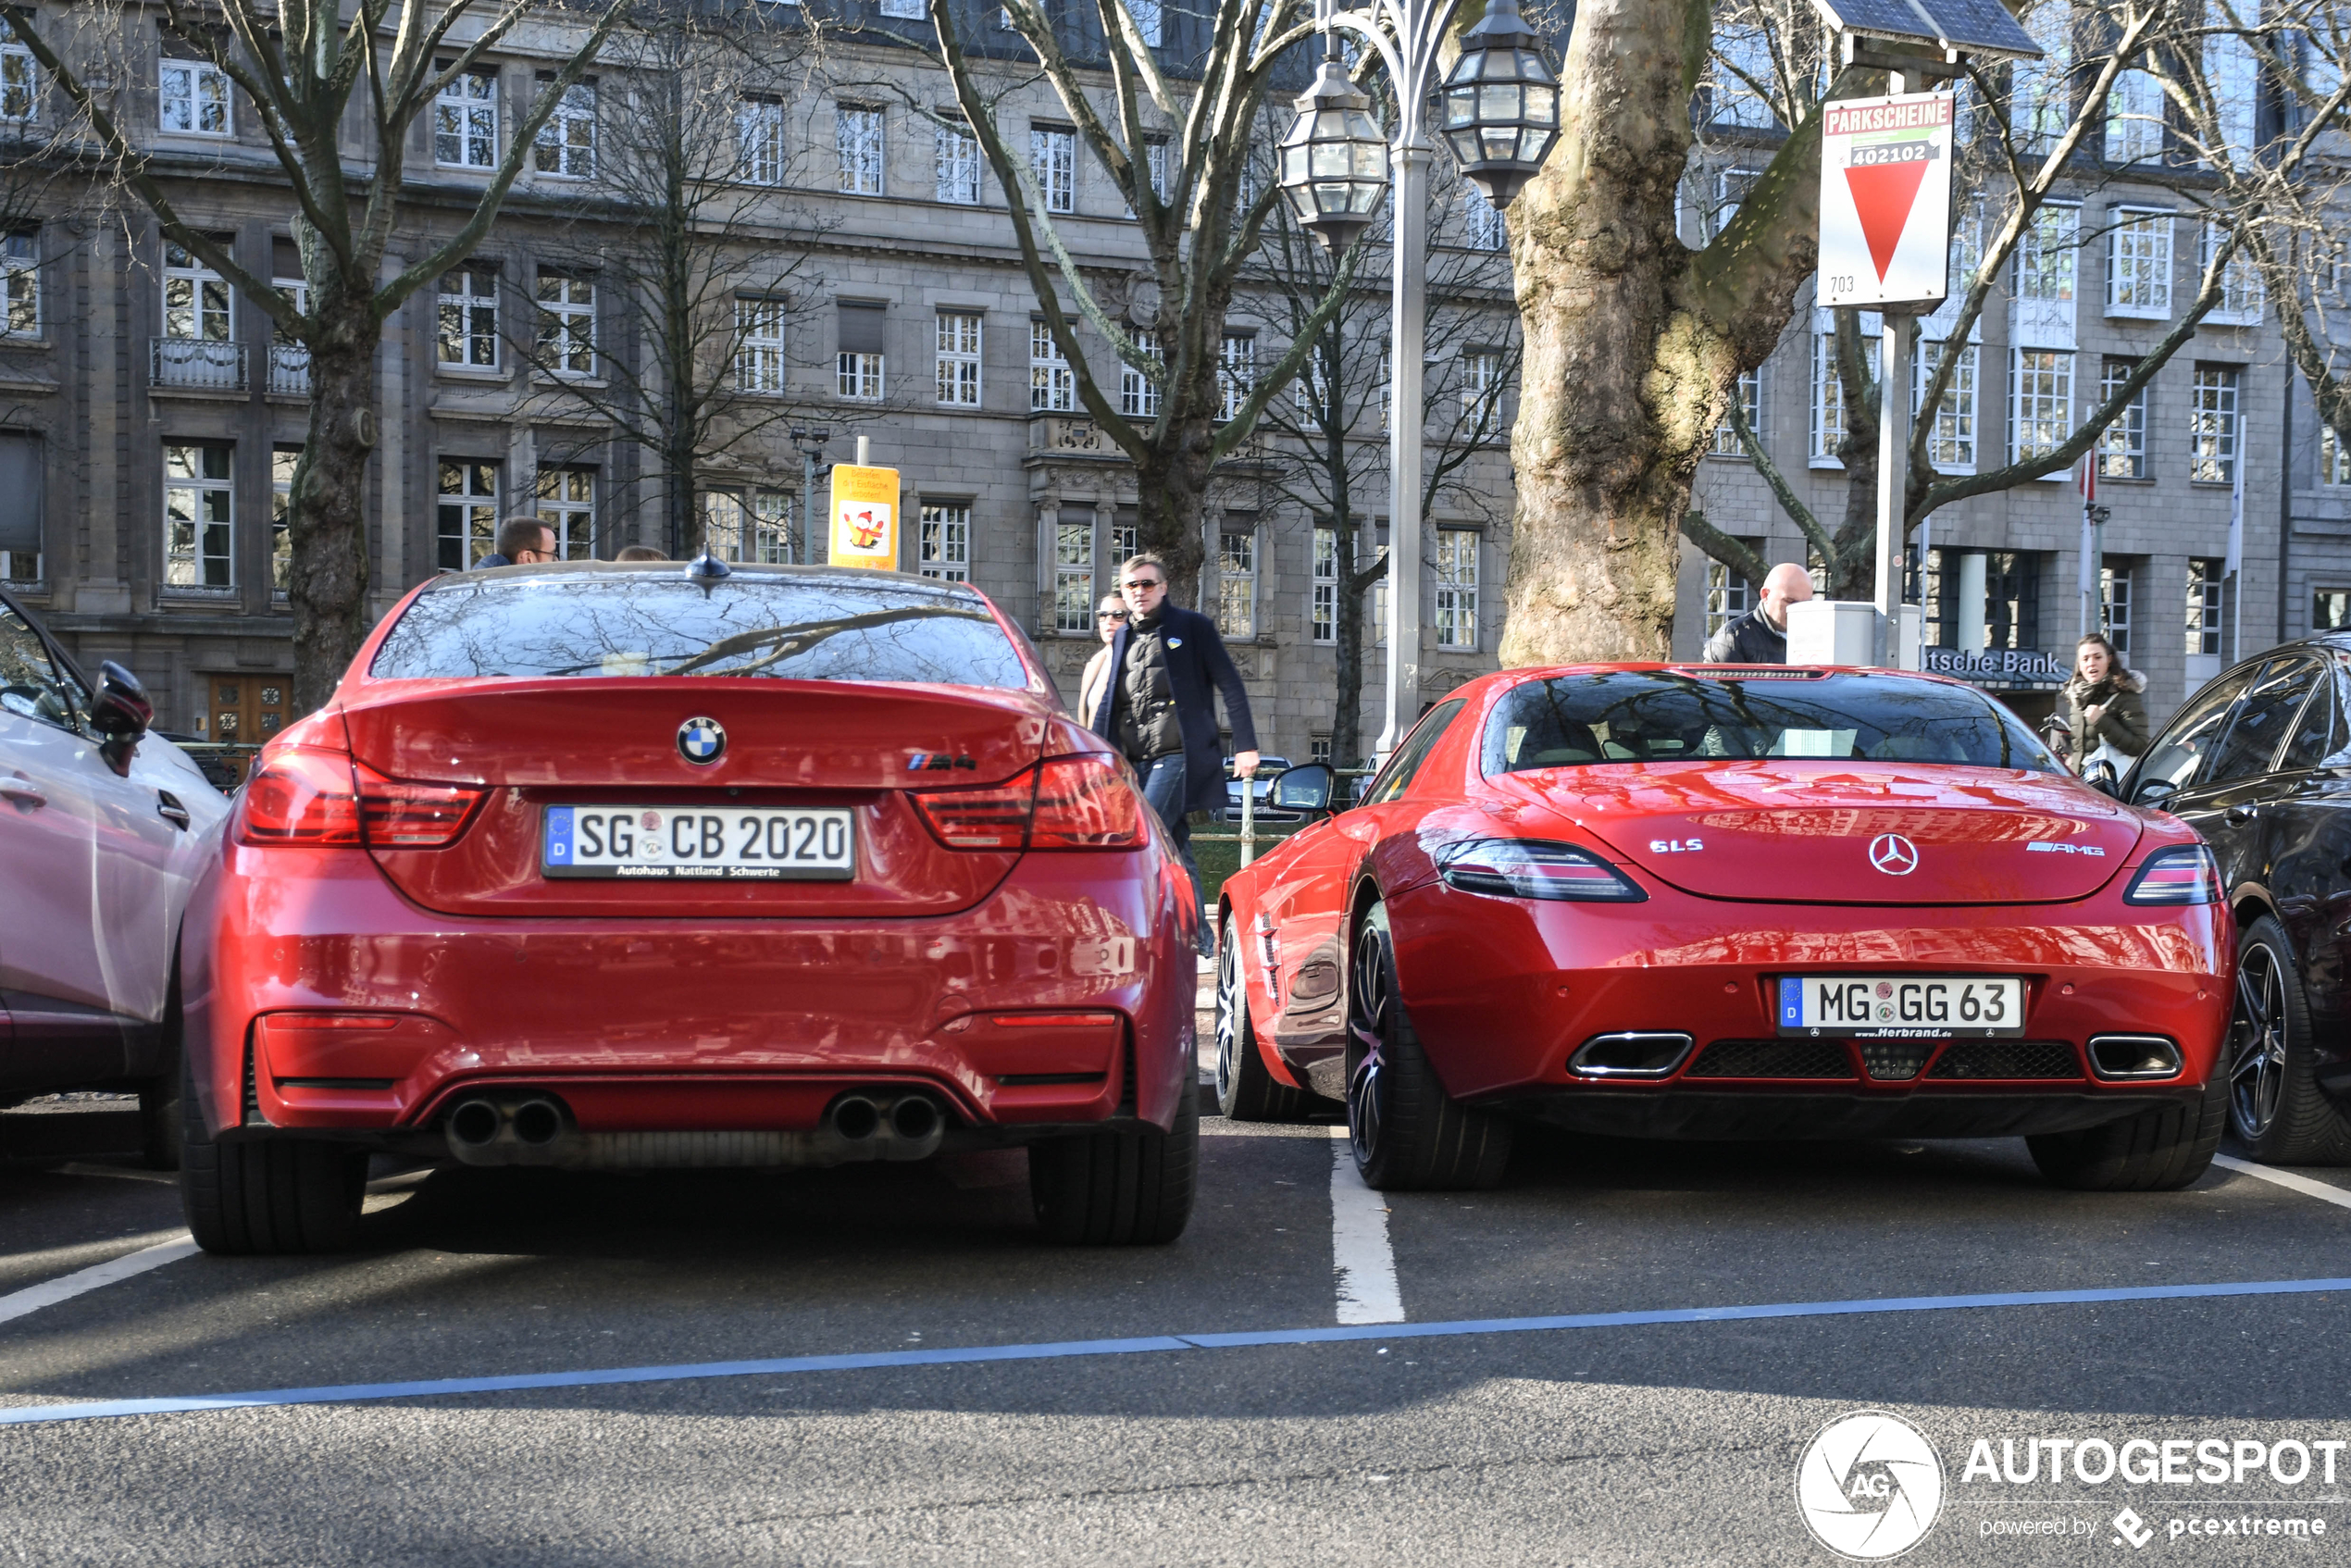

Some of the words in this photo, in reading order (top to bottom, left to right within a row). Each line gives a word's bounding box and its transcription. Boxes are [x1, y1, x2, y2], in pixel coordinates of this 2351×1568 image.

[1828, 102, 1948, 133] PARKSCHEINE
[1853, 145, 1925, 166] 402102
[1831, 276, 1854, 292] 703
[1924, 650, 1994, 672] tsche
[2003, 651, 2059, 673] Bank
[681, 718, 723, 734] BMW
[554, 843, 565, 856] D
[579, 815, 634, 858] SG
[672, 815, 725, 859] CB
[740, 816, 845, 860] 2020
[1649, 839, 1703, 852] SLS
[2052, 844, 2106, 857] AMG
[617, 866, 668, 876] Autohaus
[675, 866, 723, 876] Nattland
[729, 866, 780, 877] Schwerte
[1787, 1008, 1797, 1019] D
[1820, 983, 1870, 1021] MG
[1899, 984, 1948, 1021] GG
[1959, 984, 2006, 1022] 63
[1855, 1027, 1952, 1038] www.Herbrand.de
